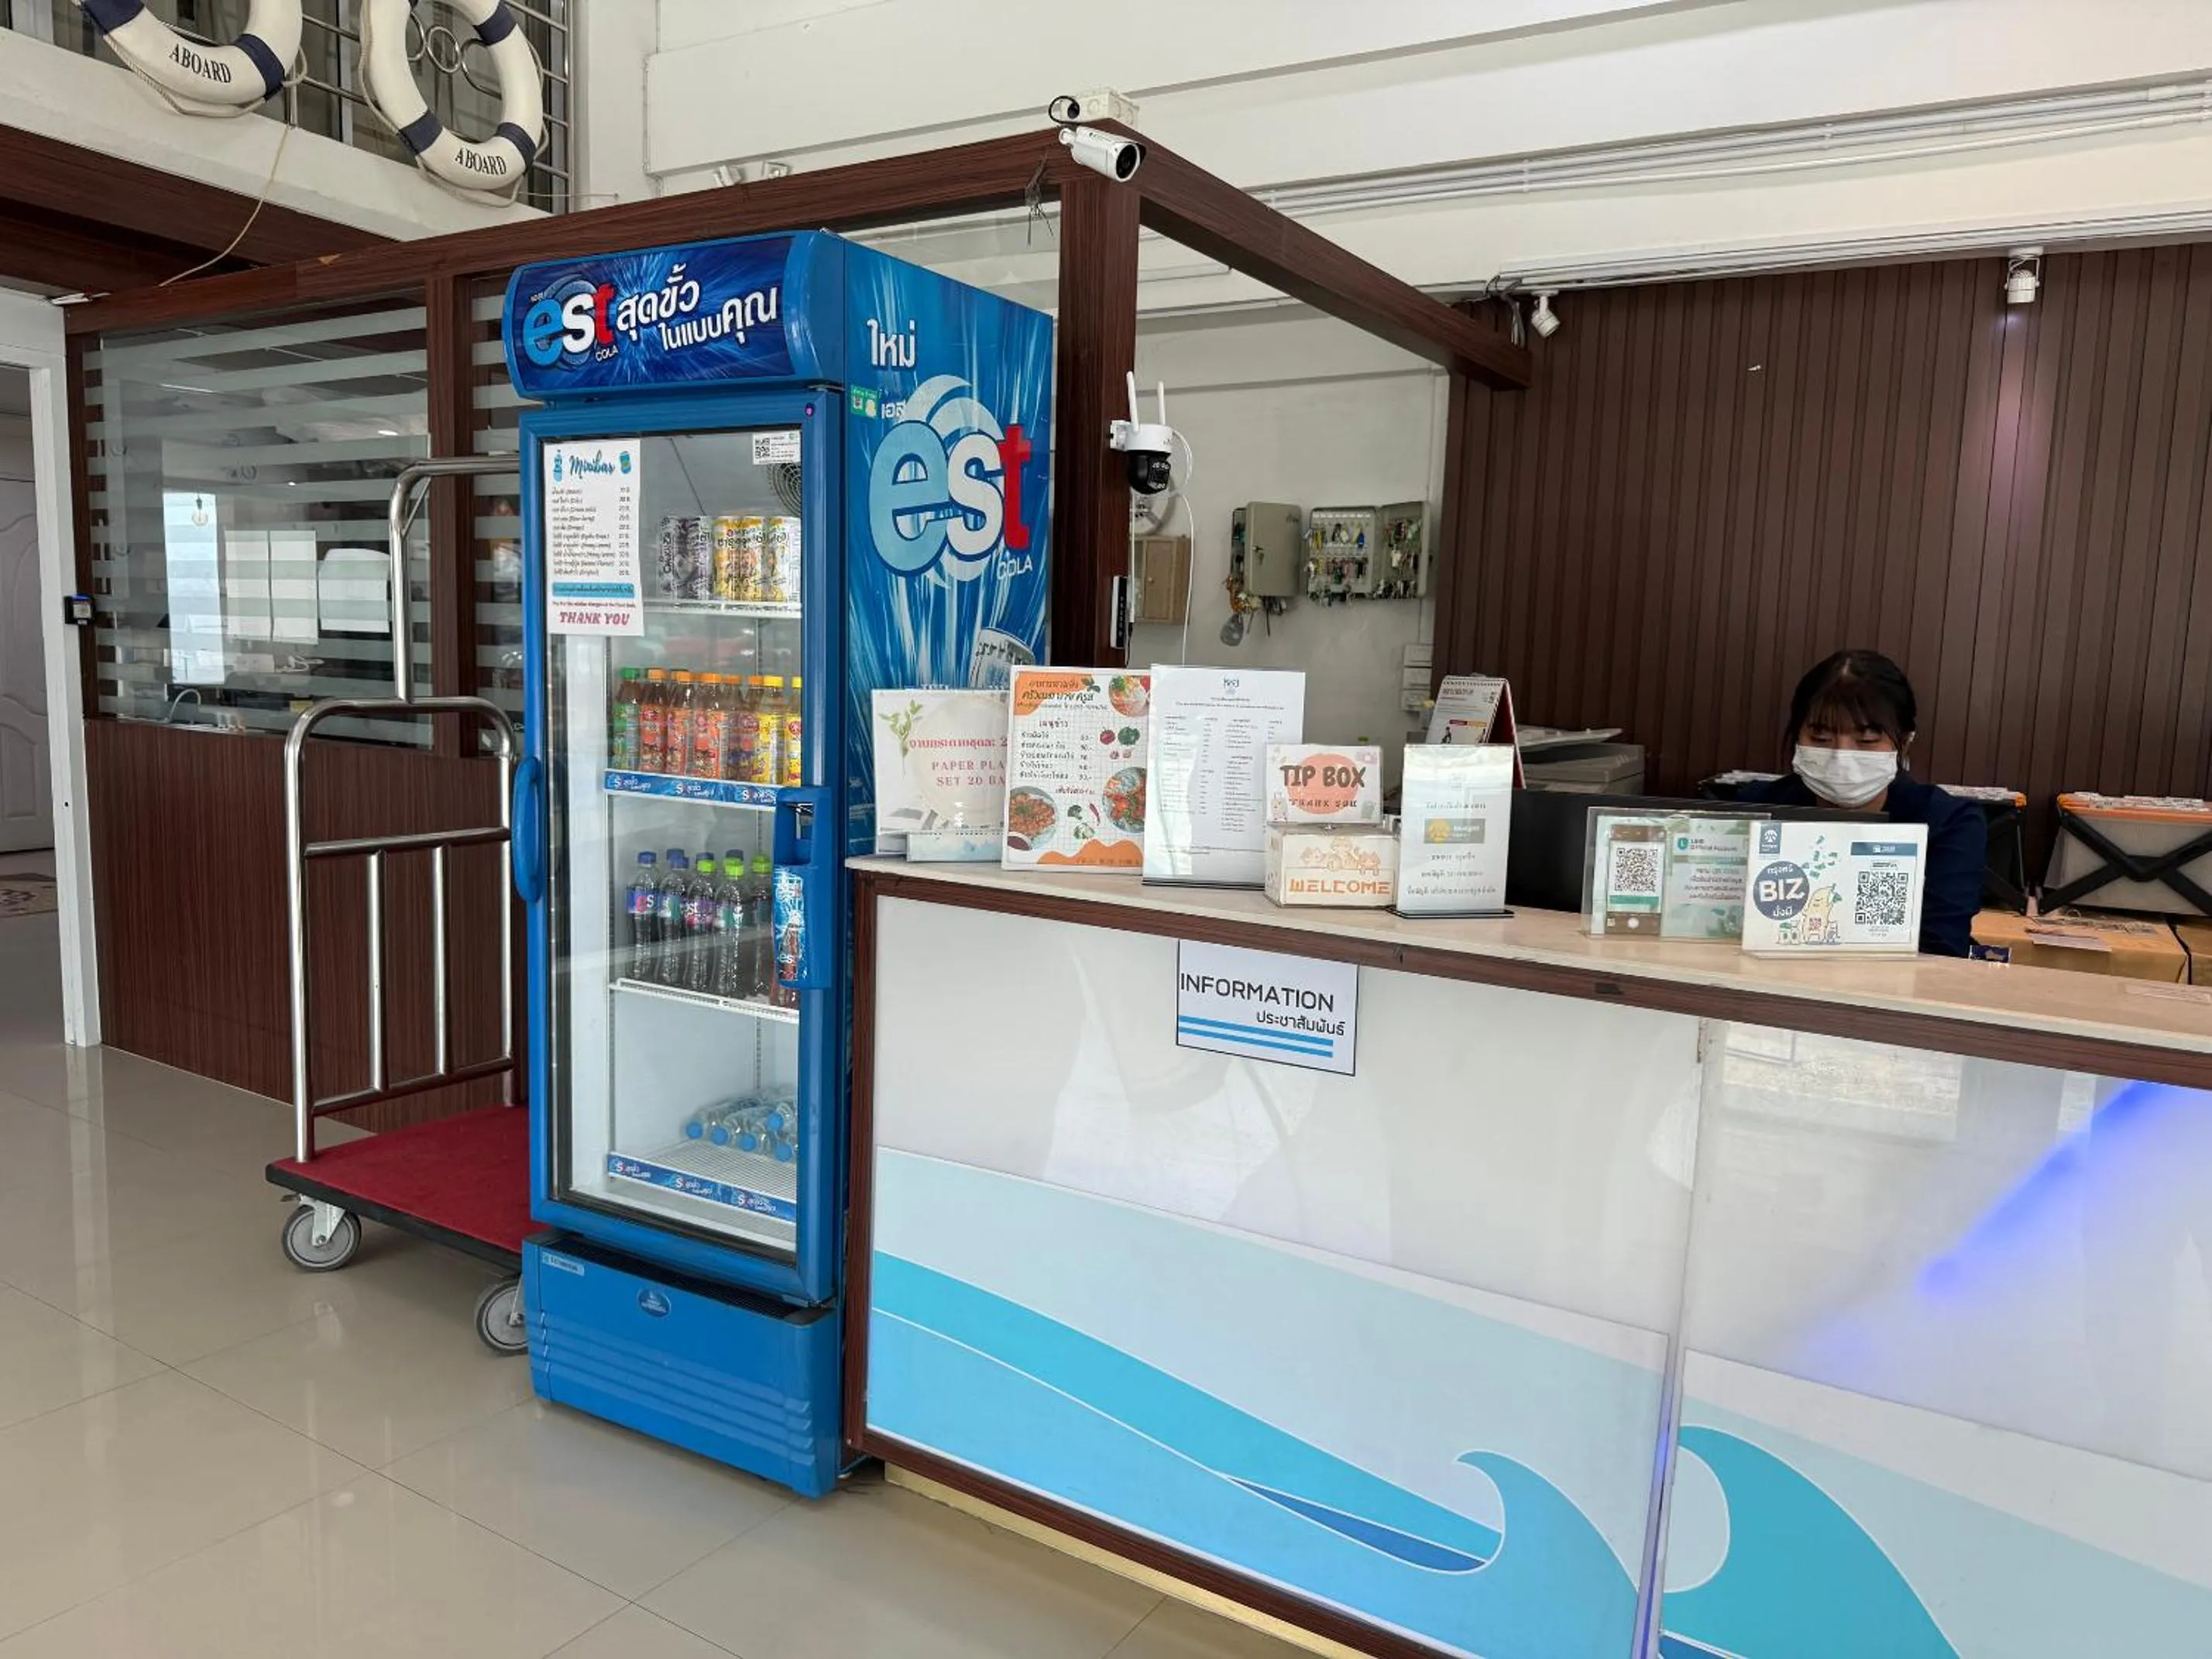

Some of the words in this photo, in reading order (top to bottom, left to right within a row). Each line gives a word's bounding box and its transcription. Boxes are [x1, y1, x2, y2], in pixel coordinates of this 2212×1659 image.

[169, 43, 232, 83] ABOARD
[455, 148, 507, 175] ABOARD
[523, 283, 615, 366] est
[658, 287, 778, 351] ในแบบคุณ
[595, 346, 618, 362] COLA
[867, 318, 916, 368] ใหม่
[869, 421, 1032, 576] est
[997, 555, 1033, 580] COLA
[560, 611, 601, 624] THANK
[604, 613, 630, 626] YOU
[932, 760, 974, 771] PAPER
[981, 761, 1005, 770] PLA
[1280, 764, 1317, 787] TIP
[1323, 765, 1366, 788] BOX
[936, 776, 960, 787] SET
[968, 776, 983, 785] 20
[989, 776, 1006, 785] BA
[1289, 878, 1390, 895] WELCOME
[1759, 878, 1805, 902] BIZ
[1180, 972, 1334, 1012] INFORMATION
[1256, 1010, 1346, 1036] ประชาสัมพันธ์
